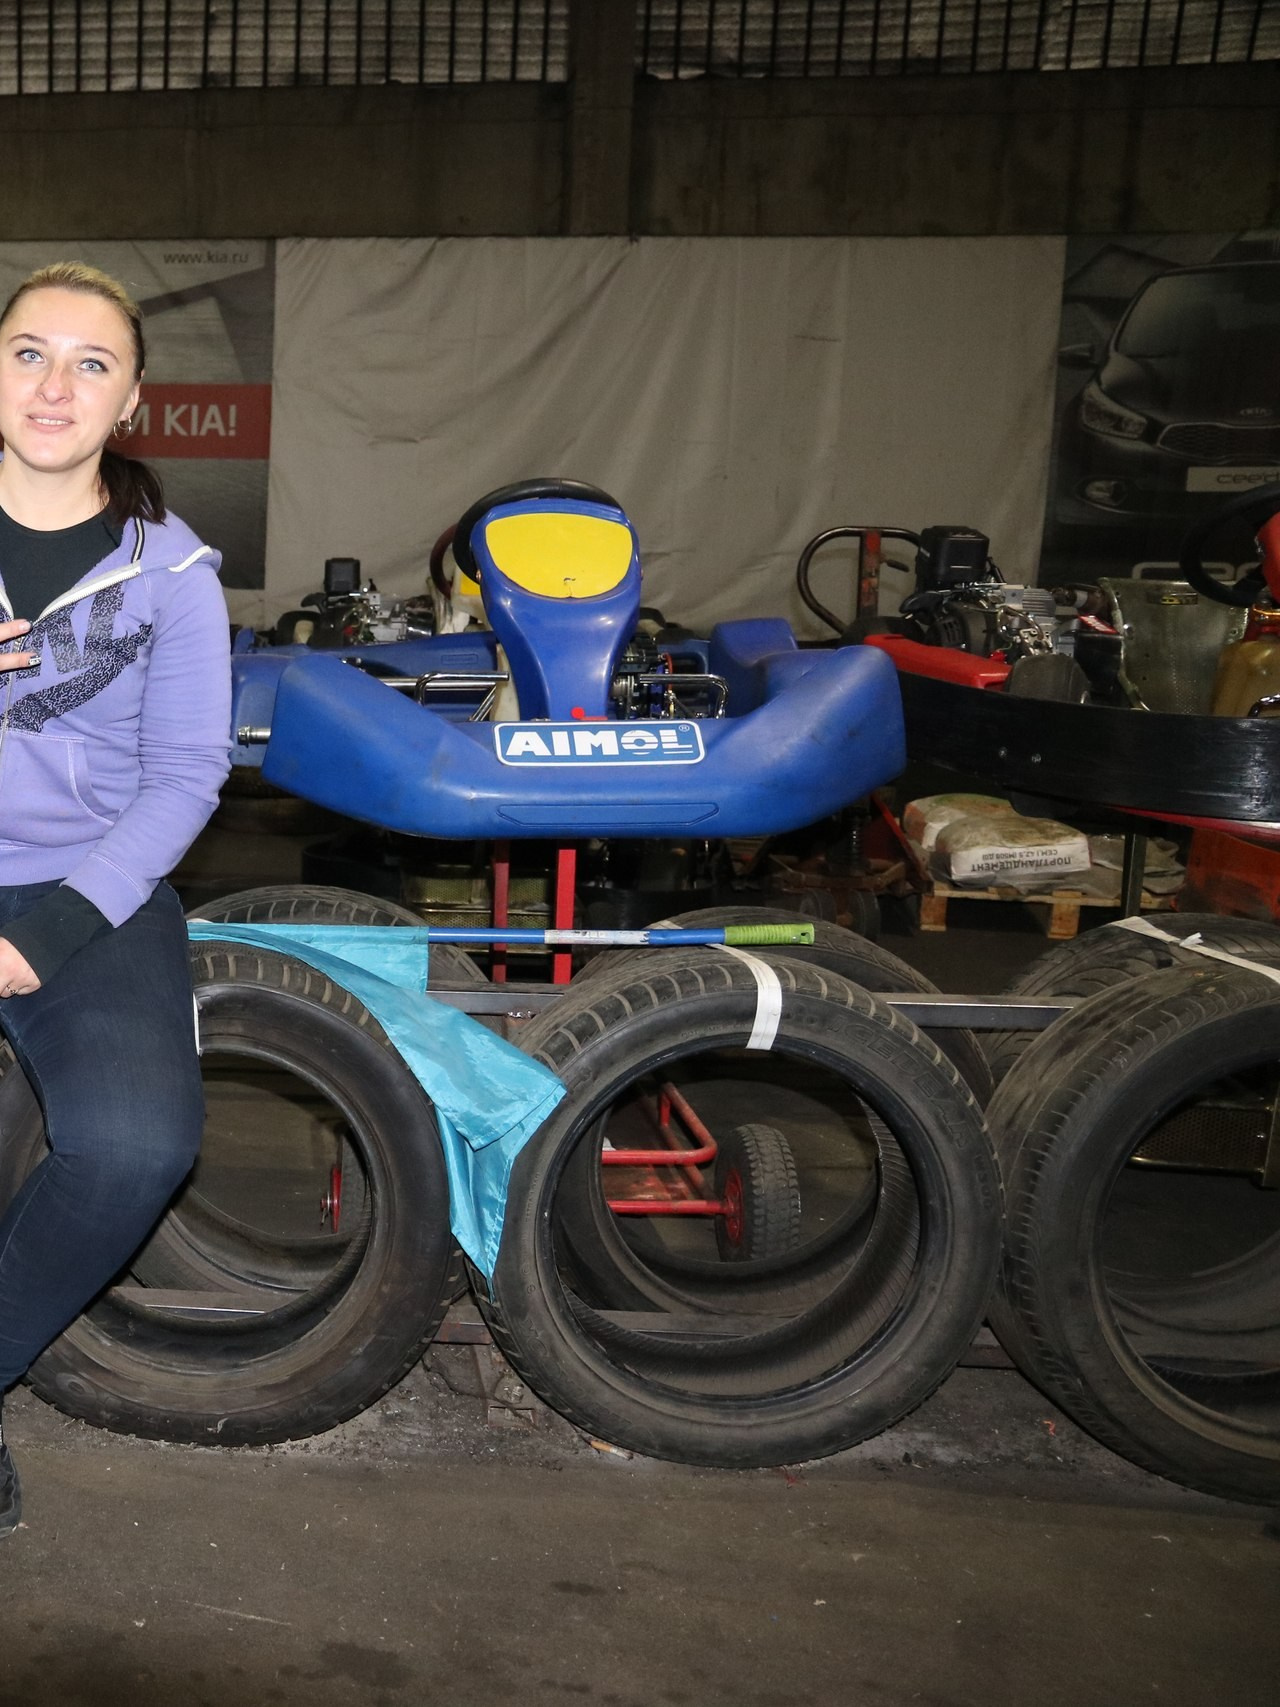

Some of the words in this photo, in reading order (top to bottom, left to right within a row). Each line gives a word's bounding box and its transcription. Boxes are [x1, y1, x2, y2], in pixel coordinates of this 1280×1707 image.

[163, 251, 249, 265] www.kia.ru
[163, 404, 237, 437] KIA!
[505, 729, 694, 756] AIMOL
[971, 856, 1072, 872] ПОРТЛАНДЦЕМЕНТ
